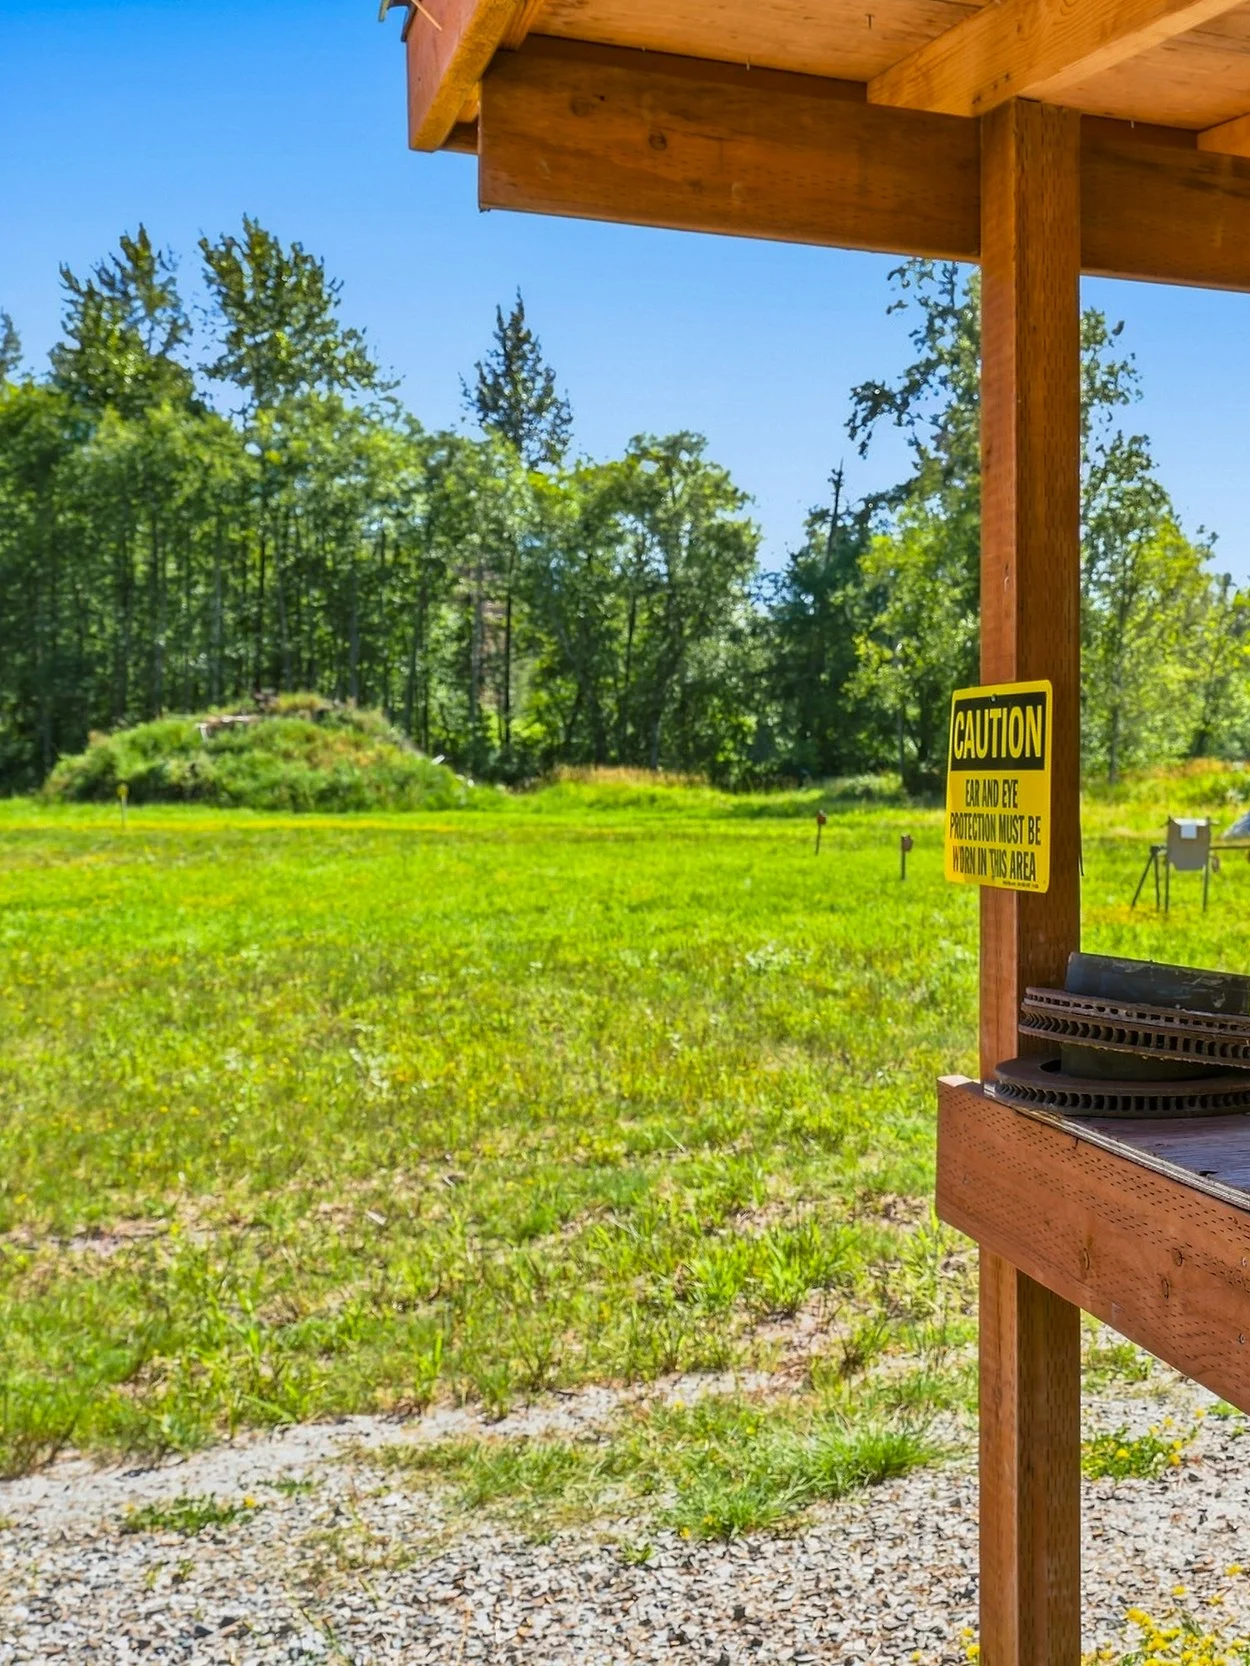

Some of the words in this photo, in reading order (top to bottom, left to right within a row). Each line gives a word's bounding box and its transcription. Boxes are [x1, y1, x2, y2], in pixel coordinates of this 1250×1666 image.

[954, 705, 1042, 759] CAUTION
[965, 779, 979, 807] EAR
[982, 779, 998, 807] AND
[1002, 779, 1018, 808] EYE
[950, 812, 996, 842] PROTECTION
[999, 815, 1024, 844] MUST
[1028, 816, 1041, 845] BE
[953, 845, 975, 874] WORN
[978, 847, 987, 875] IN
[989, 848, 1007, 878] THIS
[1010, 851, 1036, 881] AREA
